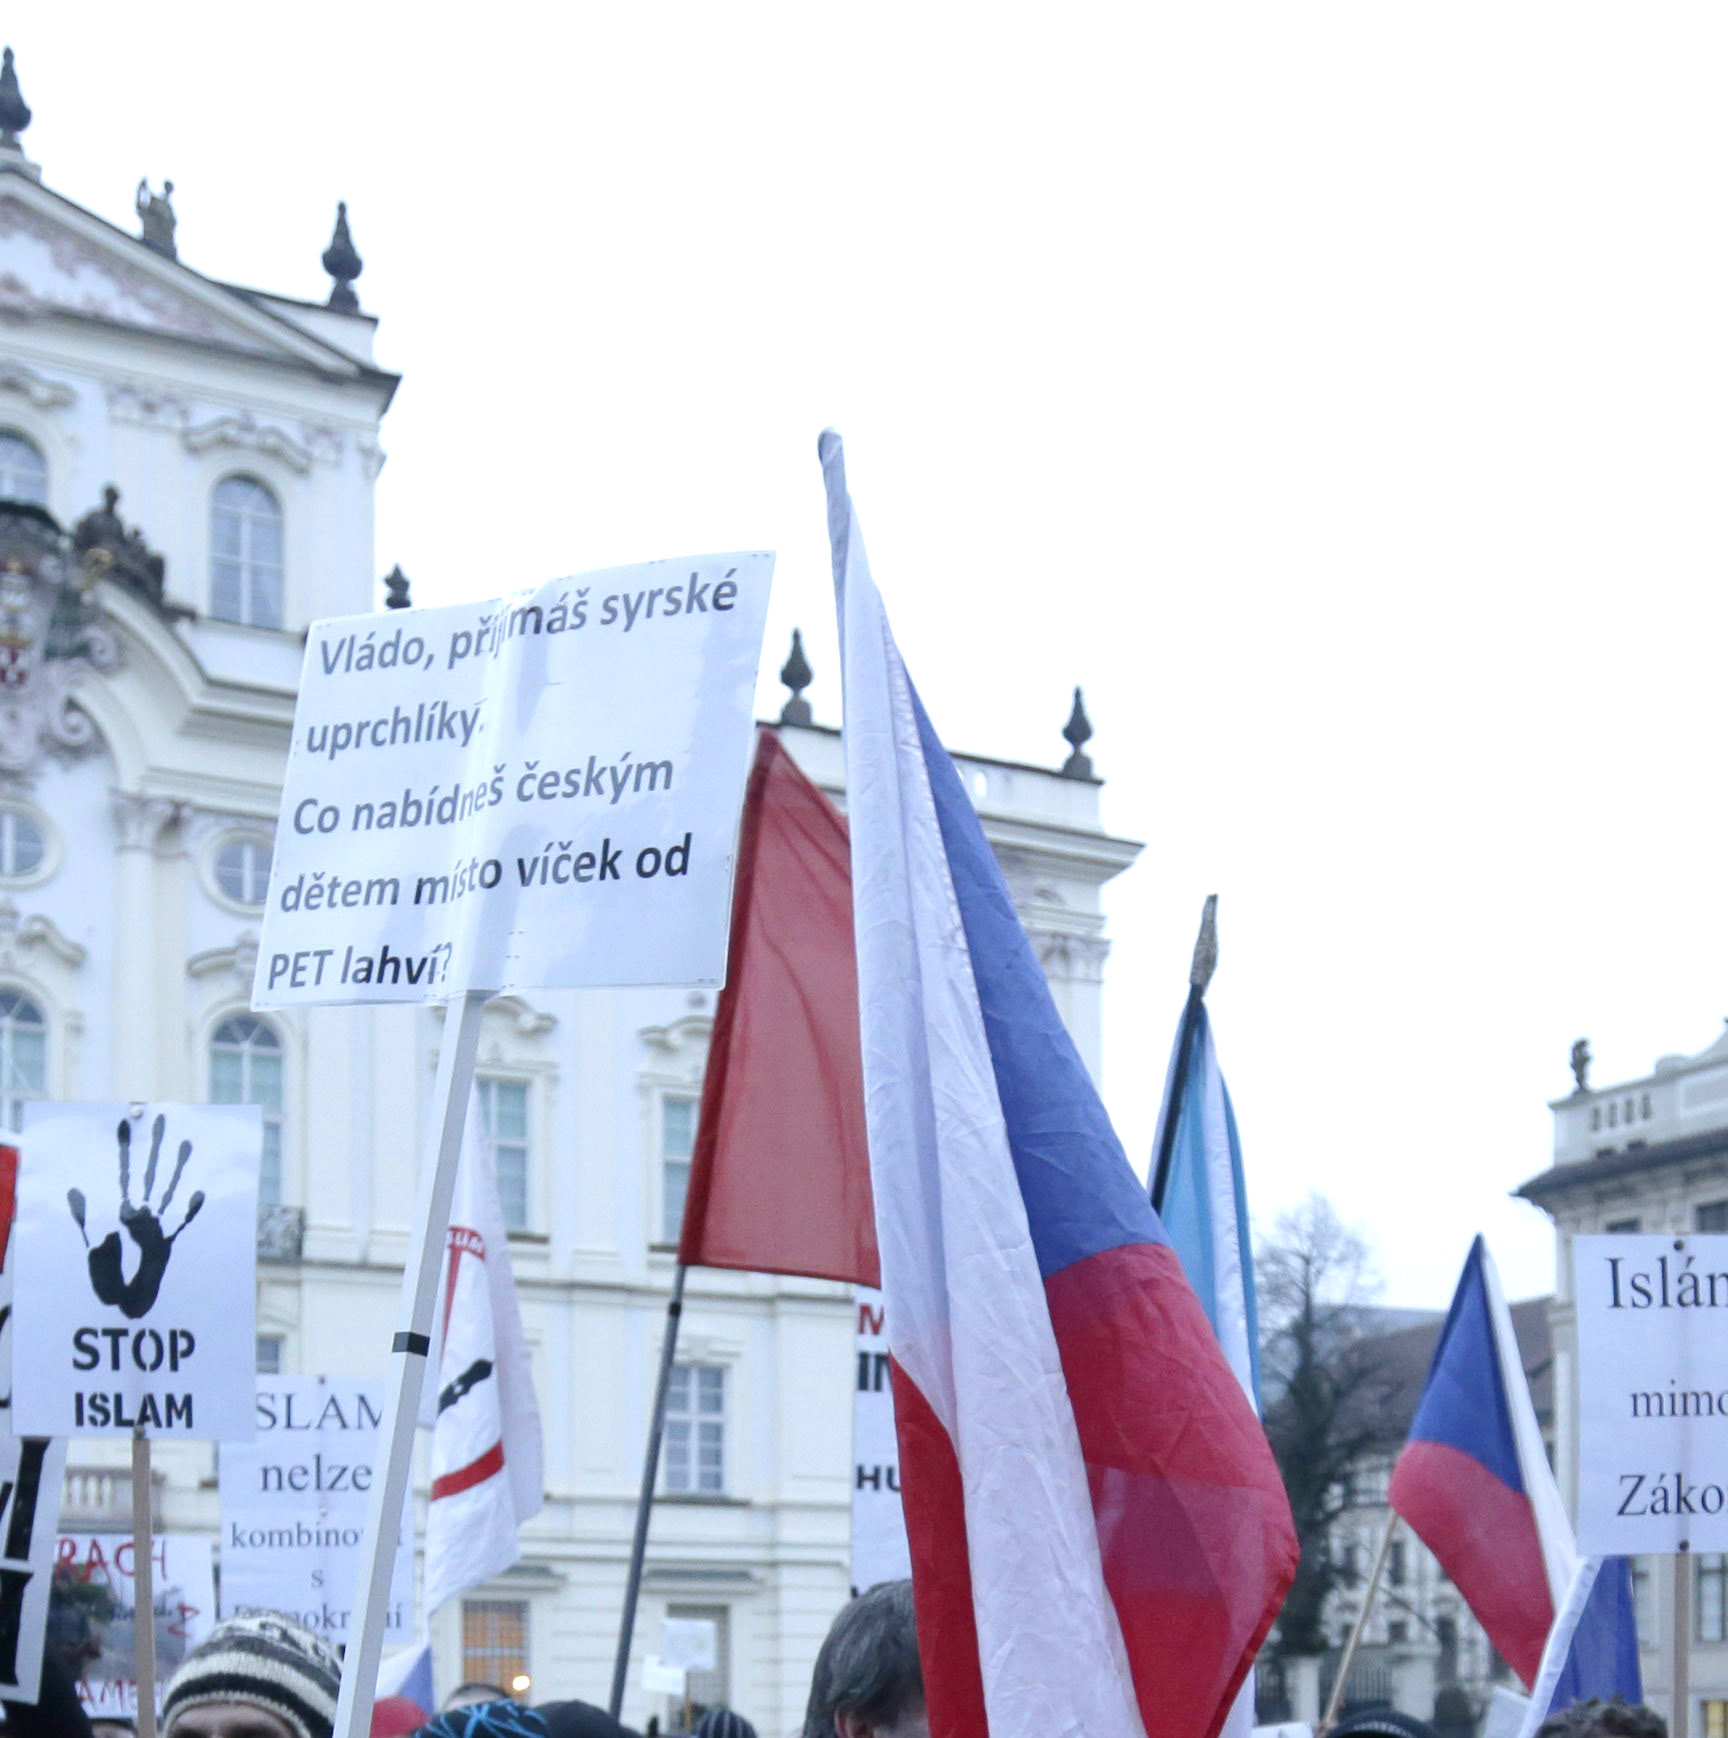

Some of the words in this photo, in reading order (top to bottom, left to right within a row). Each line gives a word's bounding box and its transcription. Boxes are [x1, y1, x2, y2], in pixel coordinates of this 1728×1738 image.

[320, 628, 435, 676] Vládo,
[447, 586, 591, 670] přijímáš
[600, 569, 739, 632] syrské
[293, 798, 340, 835] Co
[351, 763, 506, 831] nabídneš
[516, 752, 674, 805] českým
[279, 871, 400, 914] dětem
[413, 857, 503, 906] místo
[517, 838, 624, 888] víček
[635, 832, 693, 879] od
[267, 948, 334, 990] PET
[341, 942, 453, 986] lahví?
[71, 1327, 197, 1373] STOP
[74, 1391, 195, 1430] ISLAM
[260, 1452, 373, 1493] nelze
[310, 1569, 325, 1589] s
